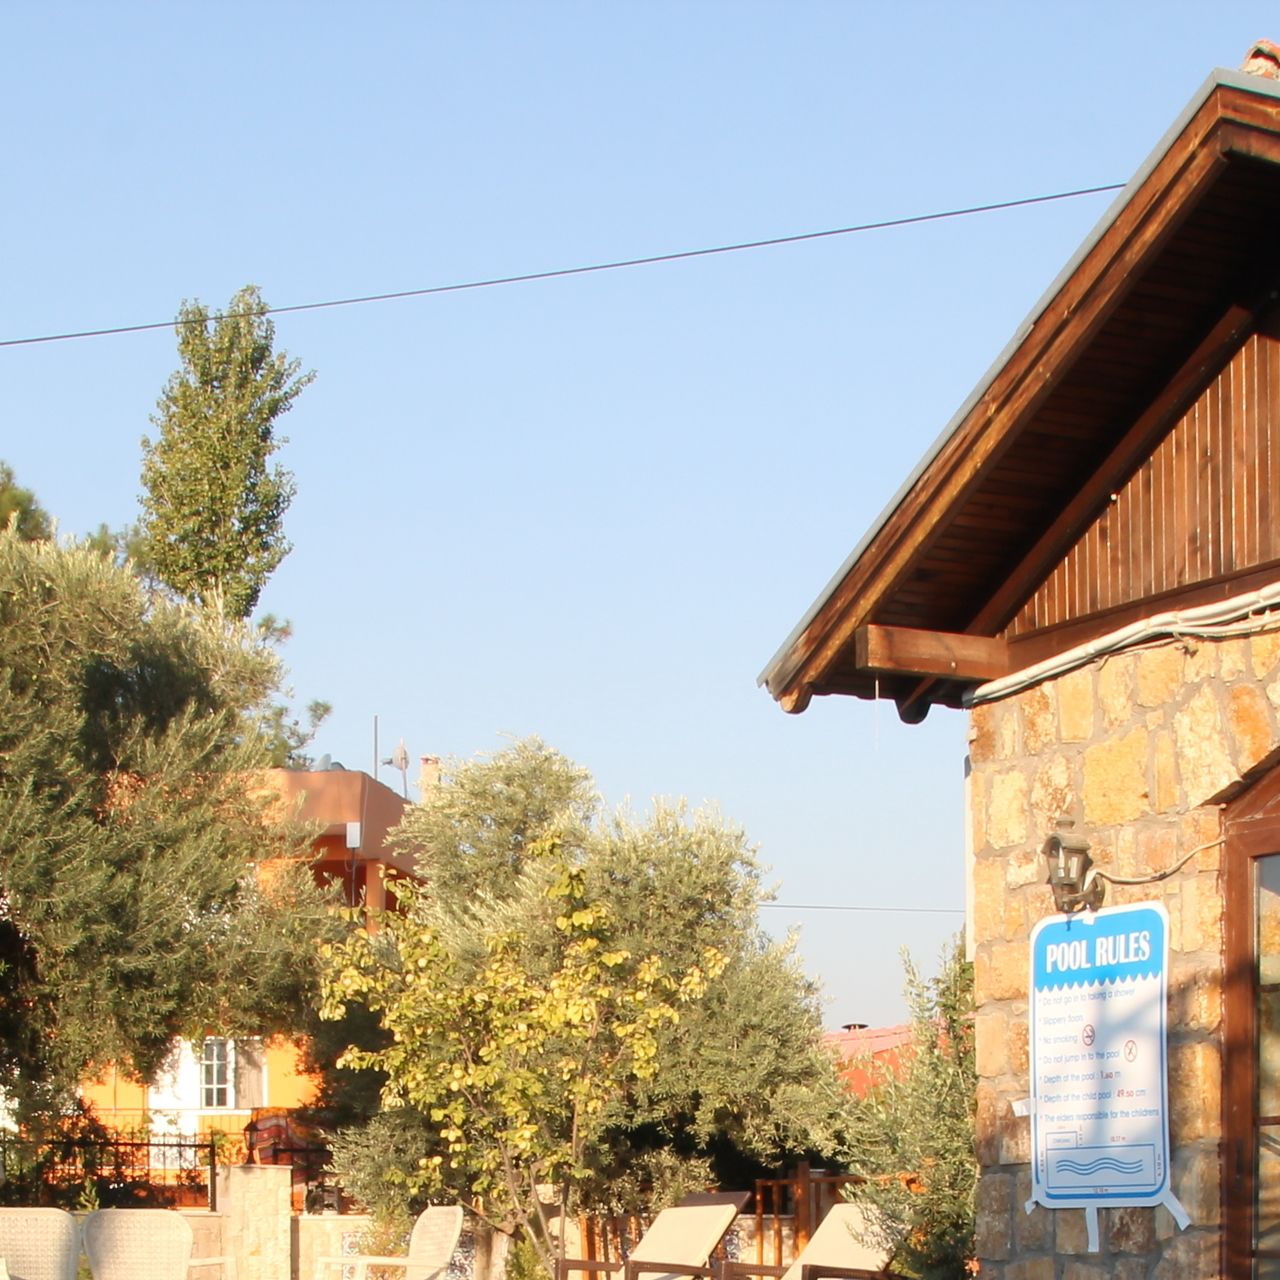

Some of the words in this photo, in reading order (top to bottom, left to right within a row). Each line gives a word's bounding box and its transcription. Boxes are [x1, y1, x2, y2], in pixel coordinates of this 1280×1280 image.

[1046, 939, 1091, 973] POOL
[1095, 930, 1151, 967] RULES
[1053, 1034, 1078, 1045] smoking
[1064, 1053, 1080, 1064] jump
[1106, 1050, 1120, 1060] pool
[1043, 1073, 1061, 1083] Depth
[1070, 1072, 1080, 1081] the
[1081, 1071, 1095, 1081] pool
[1043, 1093, 1061, 1103] Depth
[1070, 1092, 1080, 1101] the
[1081, 1091, 1096, 1101] child
[1097, 1090, 1112, 1101] pool
[1044, 1113, 1056, 1122] The
[1076, 1110, 1109, 1121] responsible
[1120, 1109, 1130, 1118] the
